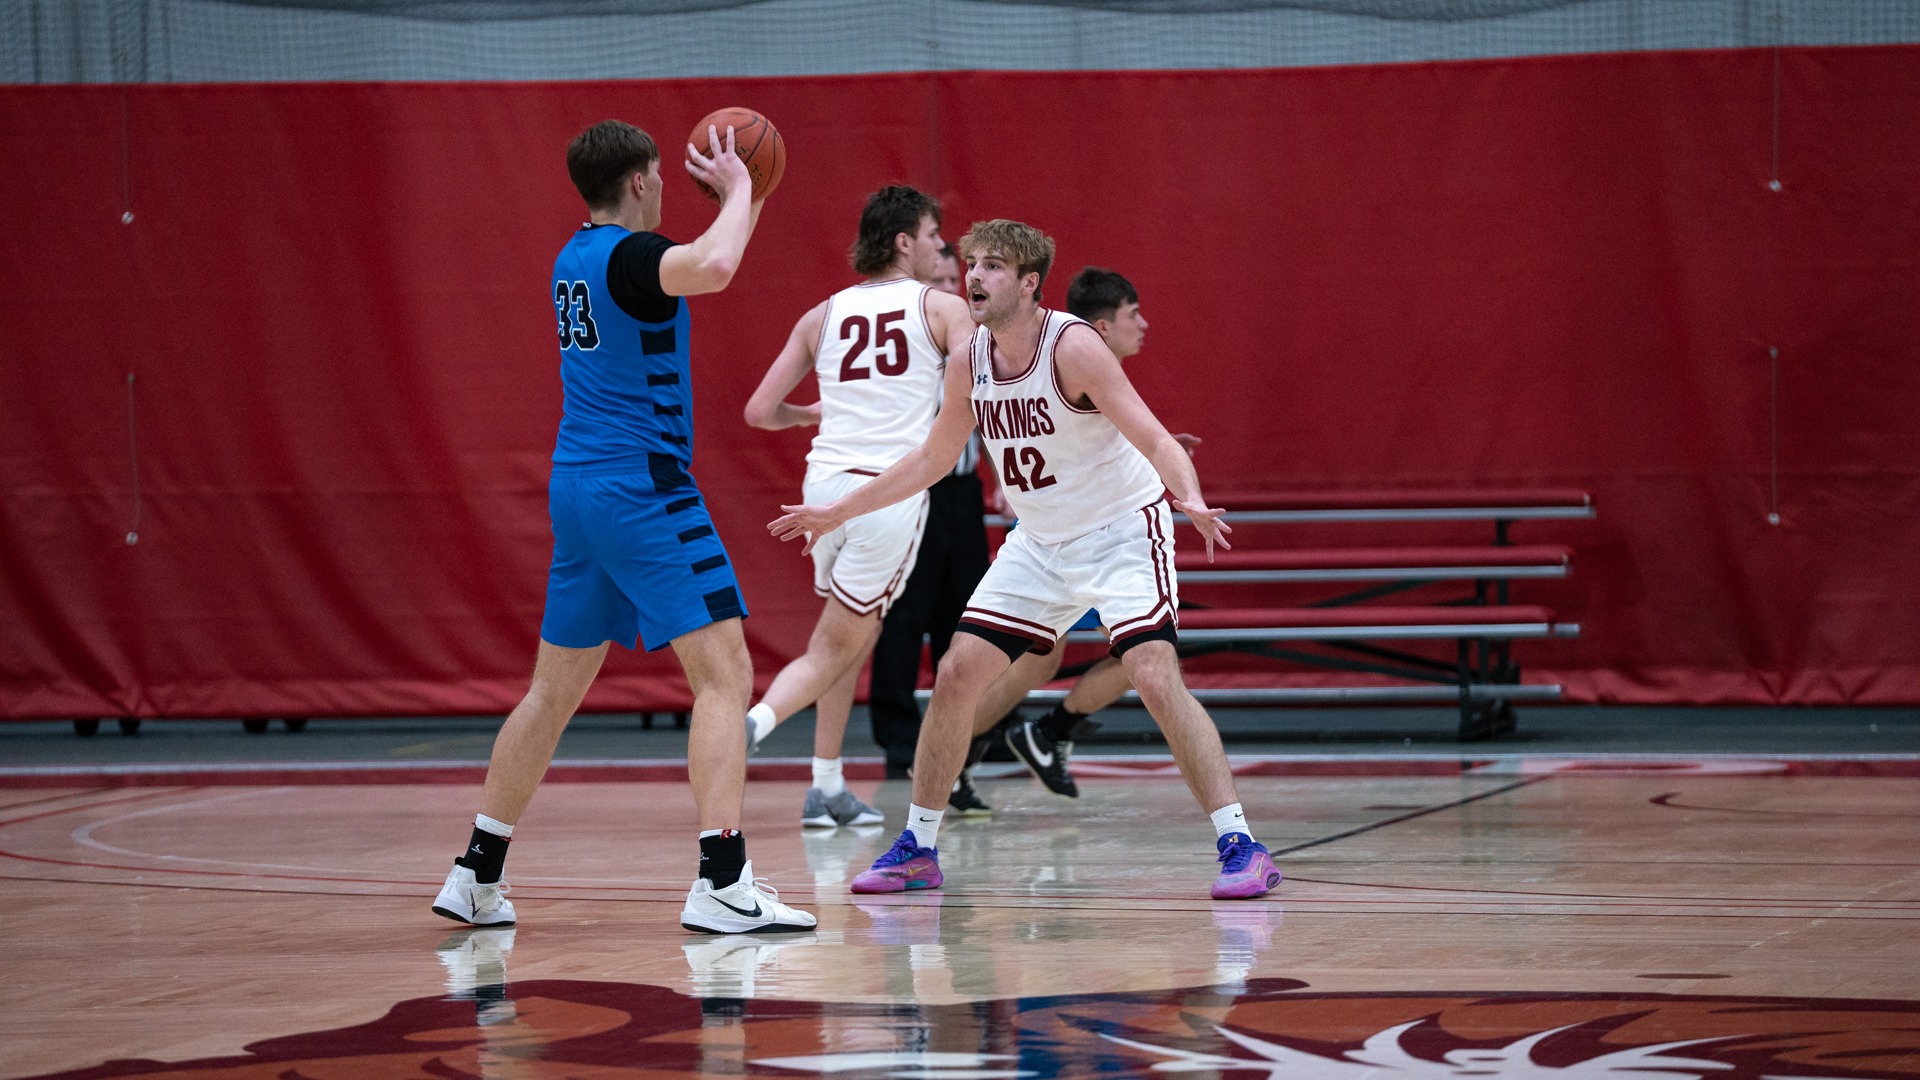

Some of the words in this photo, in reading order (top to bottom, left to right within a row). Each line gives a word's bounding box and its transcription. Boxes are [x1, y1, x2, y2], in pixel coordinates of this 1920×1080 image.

[555, 280, 600, 351] 33
[839, 309, 910, 382] 25
[974, 397, 1055, 439] VIKINGS
[1003, 446, 1057, 492] 42
